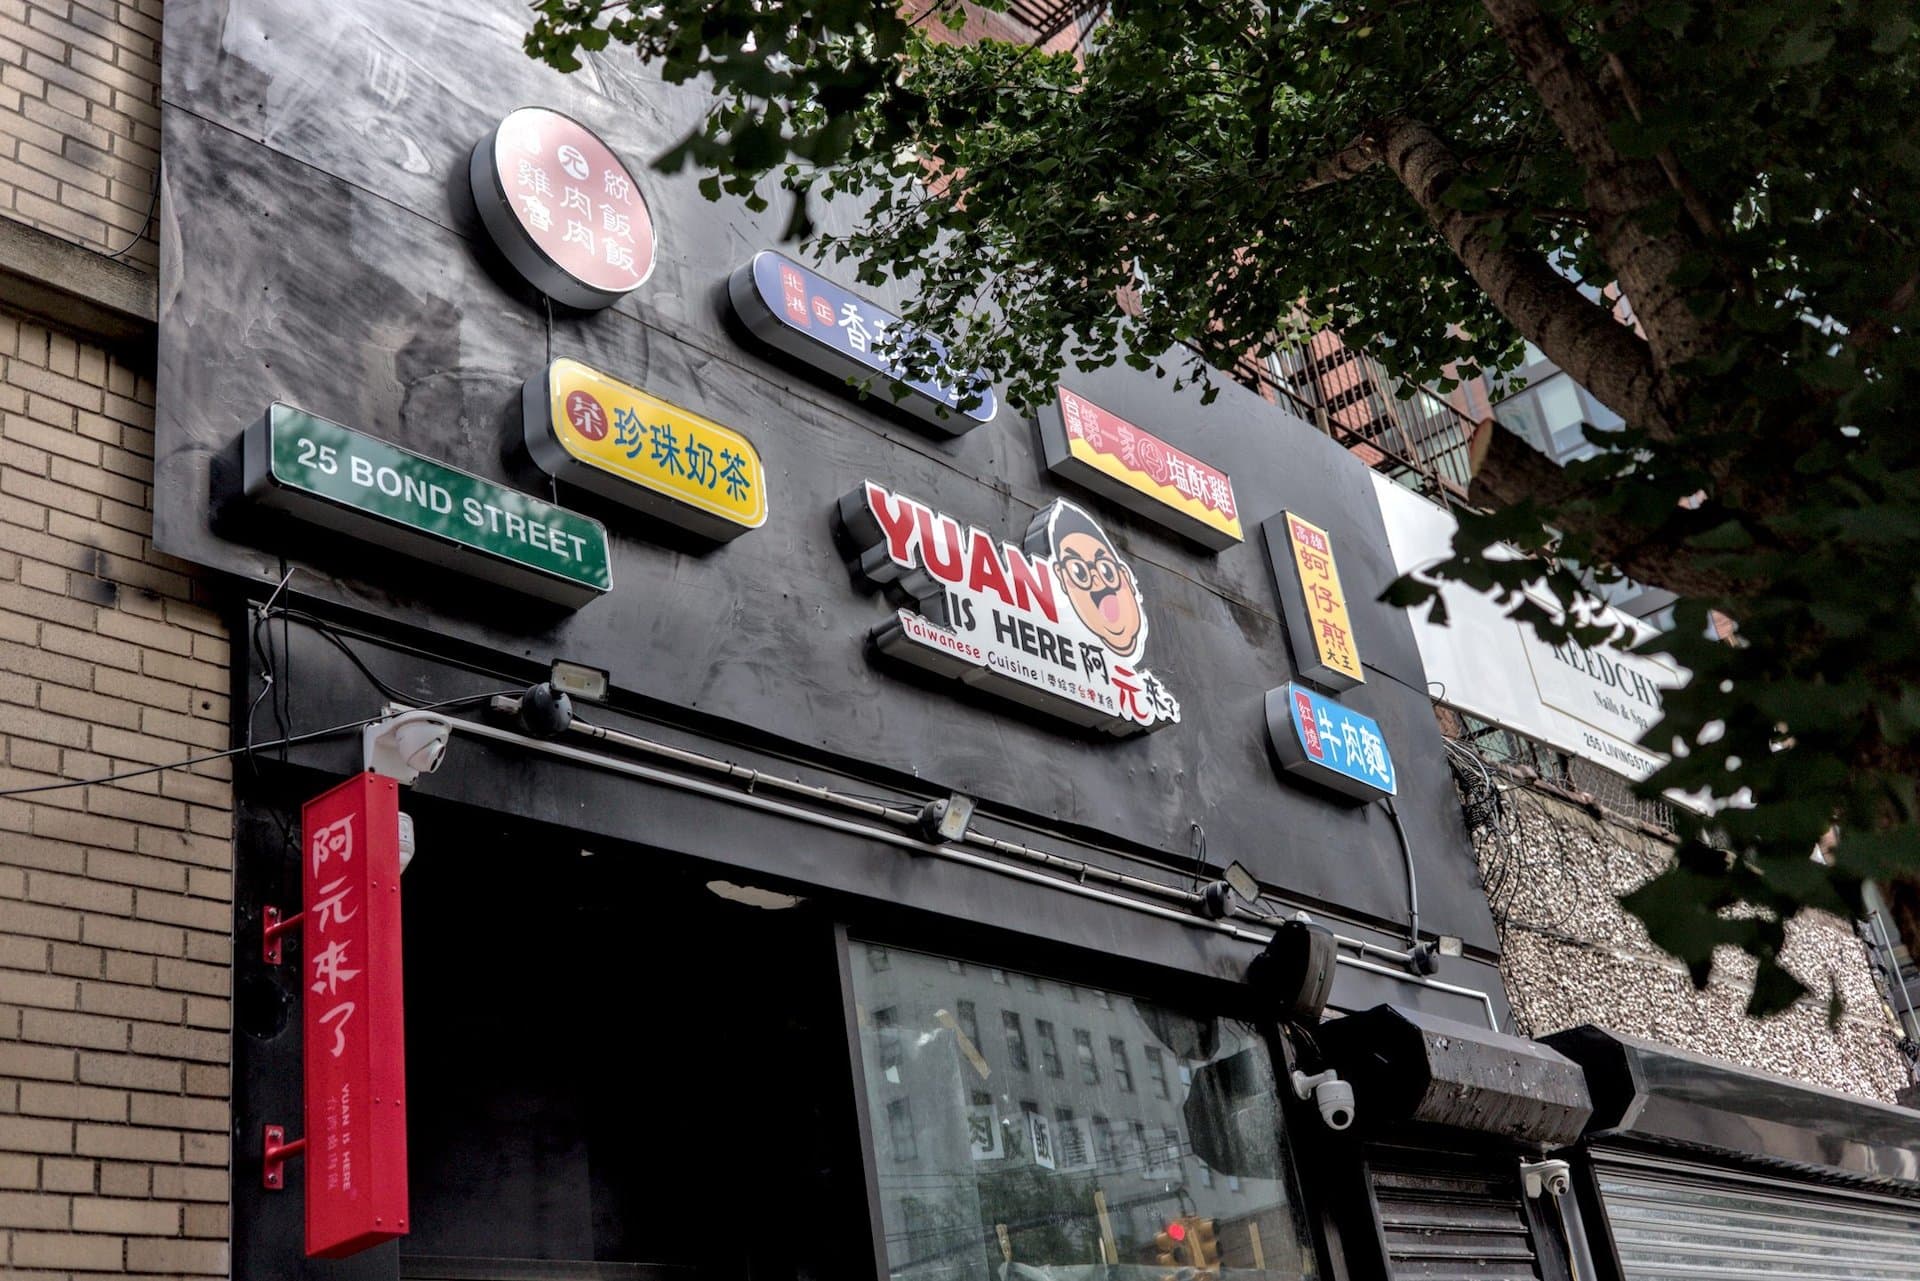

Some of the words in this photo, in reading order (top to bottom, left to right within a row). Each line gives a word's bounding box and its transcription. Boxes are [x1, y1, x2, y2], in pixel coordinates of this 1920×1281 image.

[614, 407, 750, 501] 珍珠奶茶
[297, 439, 338, 475] 25
[351, 455, 452, 514] BOND
[463, 497, 586, 562] STREET
[868, 486, 1059, 623] YUAN
[951, 592, 976, 631] IS
[992, 609, 1077, 671] HERE
[1301, 547, 1349, 654] 蚵仔煎
[904, 617, 980, 659] Taiwanese
[987, 651, 1038, 680] Cuisine
[1328, 649, 1353, 671] 大王
[342, 1083, 350, 1126] YUAN
[343, 1151, 351, 1192] HERE
